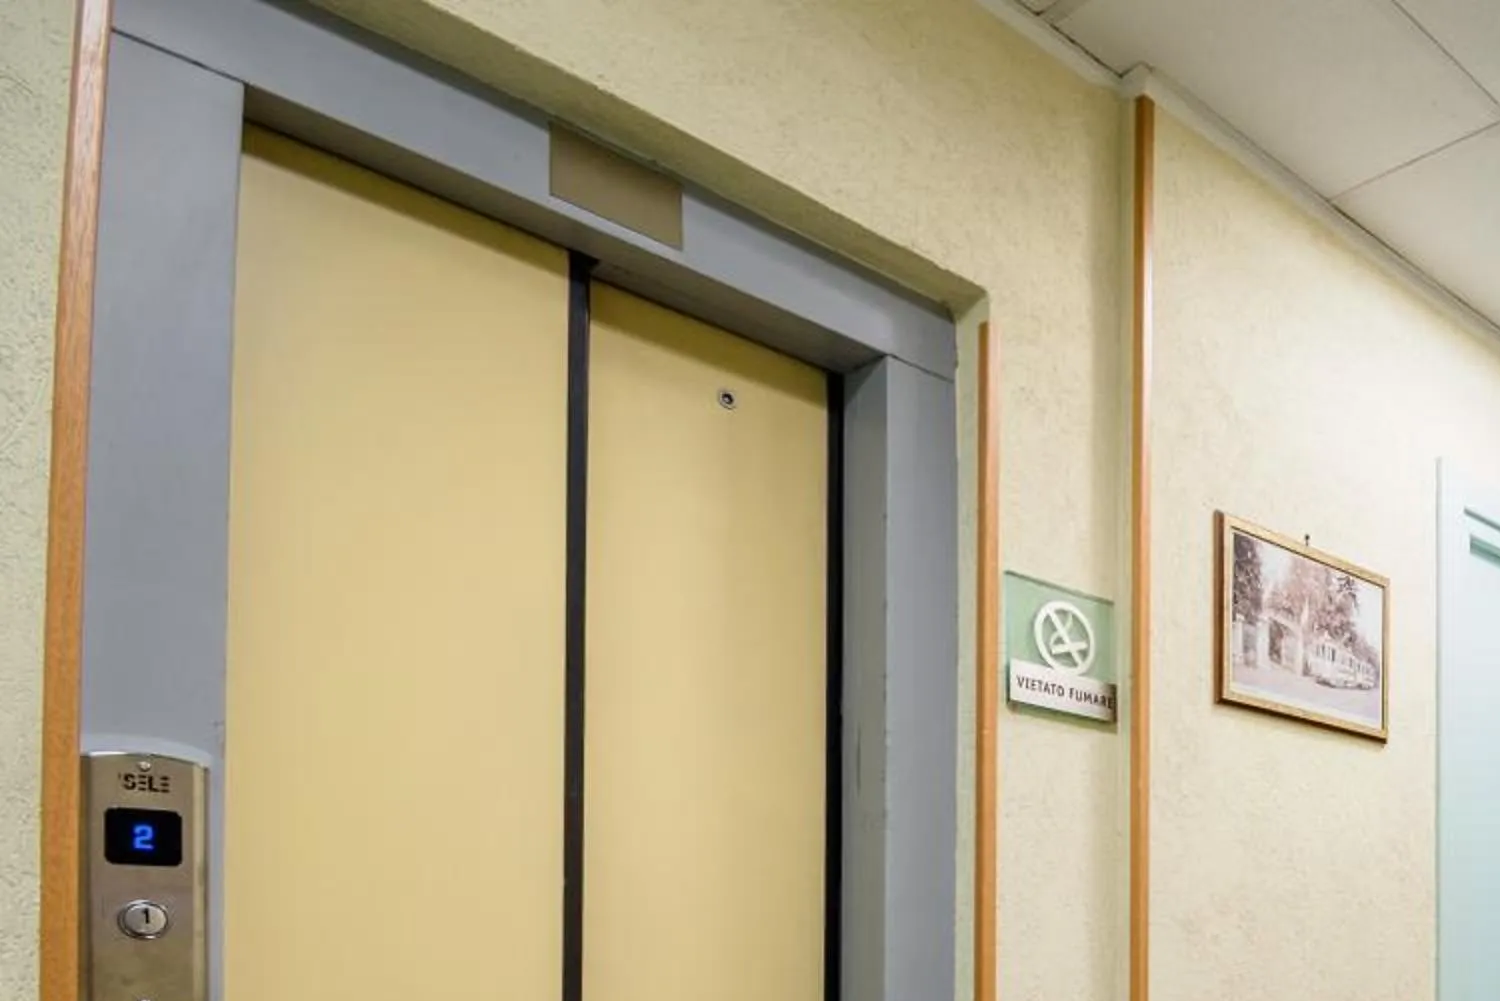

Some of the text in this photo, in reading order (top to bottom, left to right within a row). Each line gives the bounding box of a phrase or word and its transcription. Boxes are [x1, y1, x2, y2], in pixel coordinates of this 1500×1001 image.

[1016, 675, 1113, 709] VIETATO FUMARE
[122, 774, 170, 793] SELE
[133, 825, 154, 850] 2
[142, 908, 150, 924] 1
